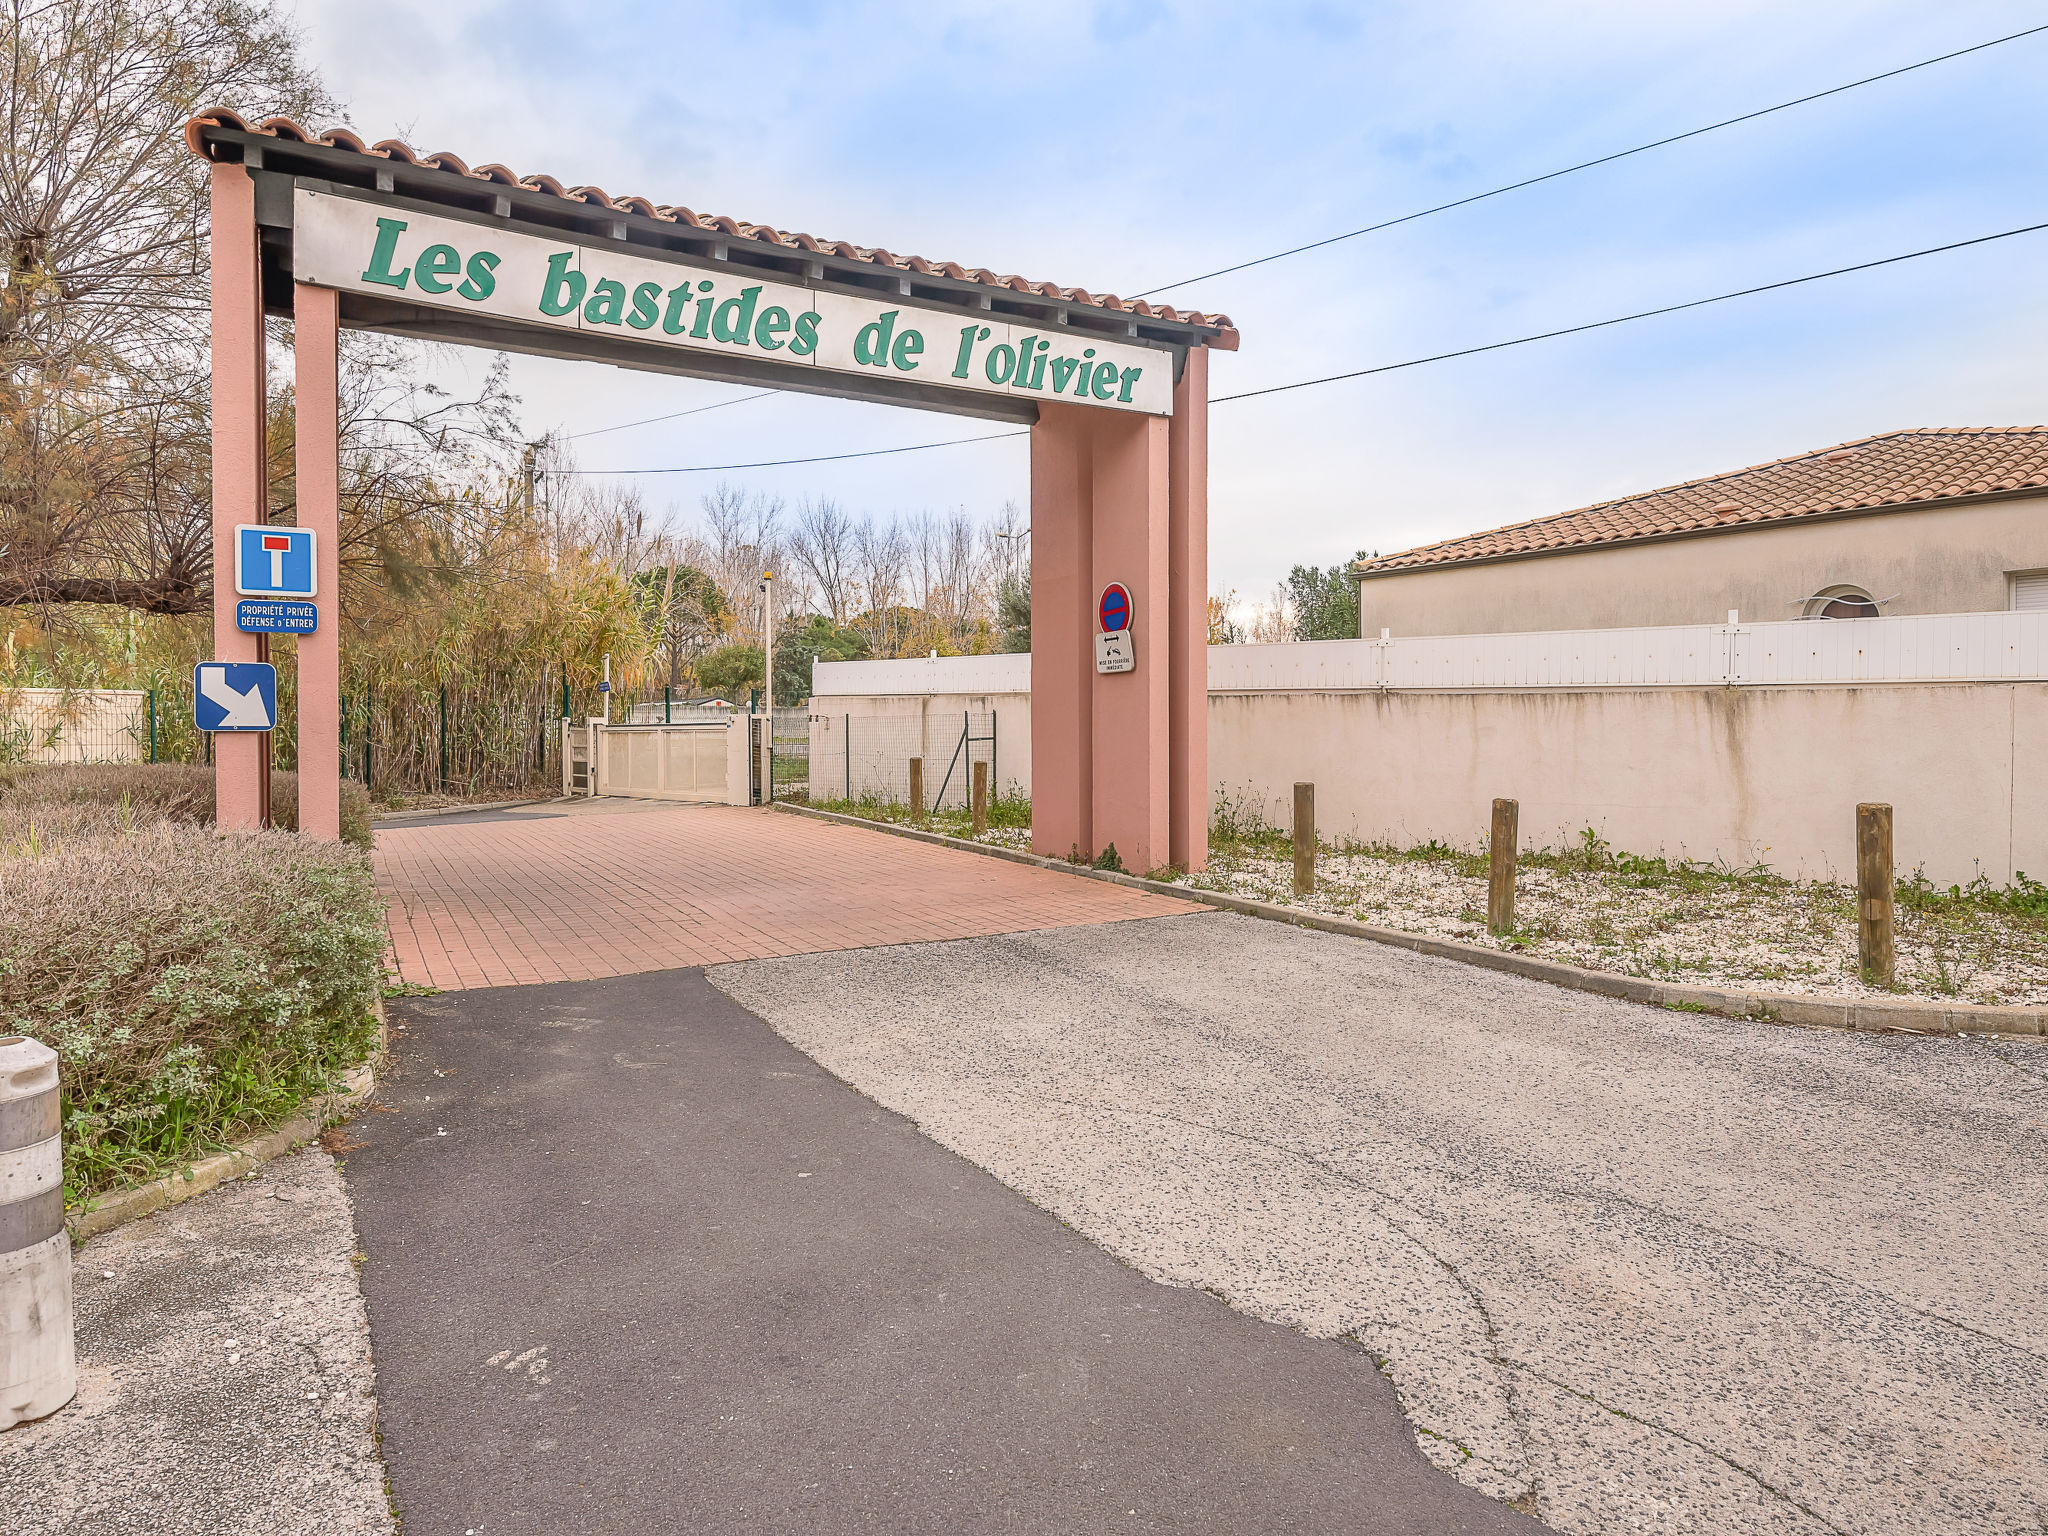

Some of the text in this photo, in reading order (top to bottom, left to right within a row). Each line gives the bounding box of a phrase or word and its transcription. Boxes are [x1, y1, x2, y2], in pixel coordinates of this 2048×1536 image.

[361, 217, 1143, 403] Les bastides de l'olivier
[241, 604, 314, 617] PROPRIÉTÉ PRIVÉE
[241, 615, 275, 627] DÉFENSE
